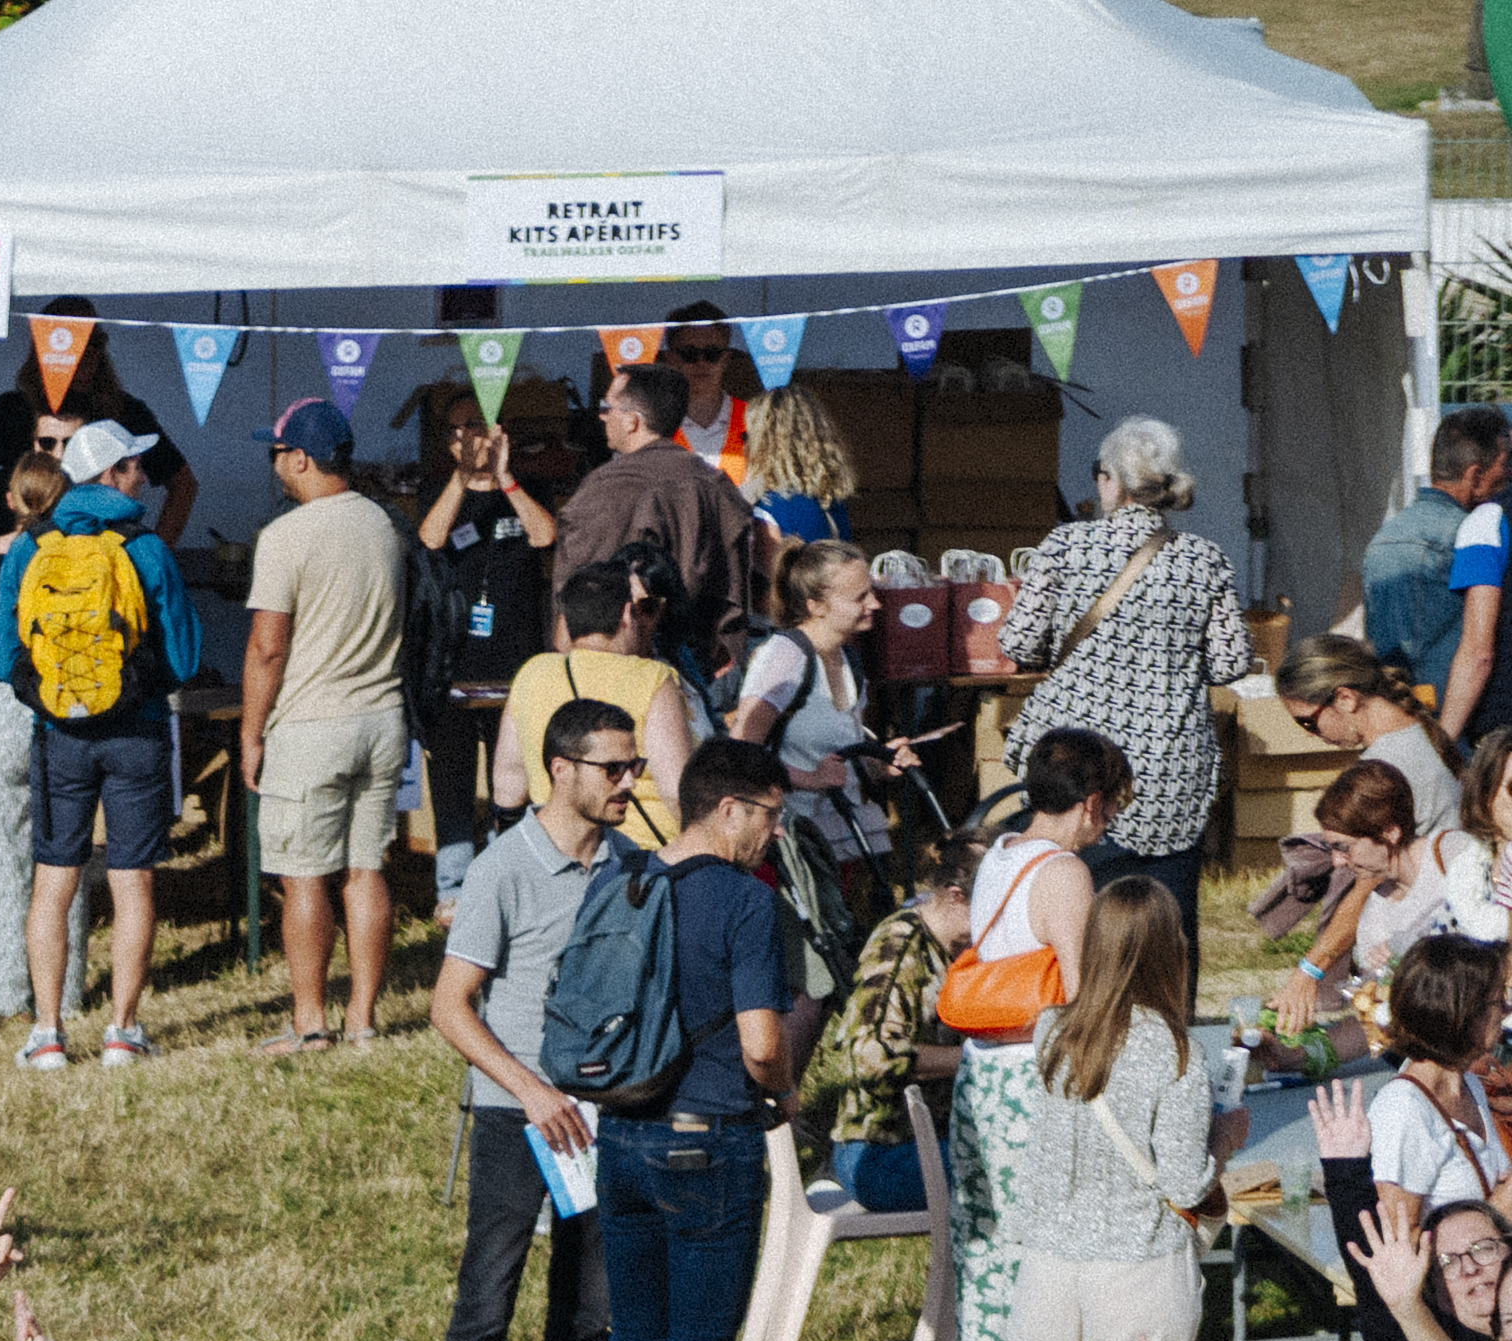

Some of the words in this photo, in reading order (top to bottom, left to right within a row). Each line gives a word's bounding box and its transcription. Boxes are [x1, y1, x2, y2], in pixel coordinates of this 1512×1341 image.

[547, 201, 642, 219] RETRAIT
[510, 225, 558, 243] KITS
[567, 220, 680, 242] APÉRITIFS
